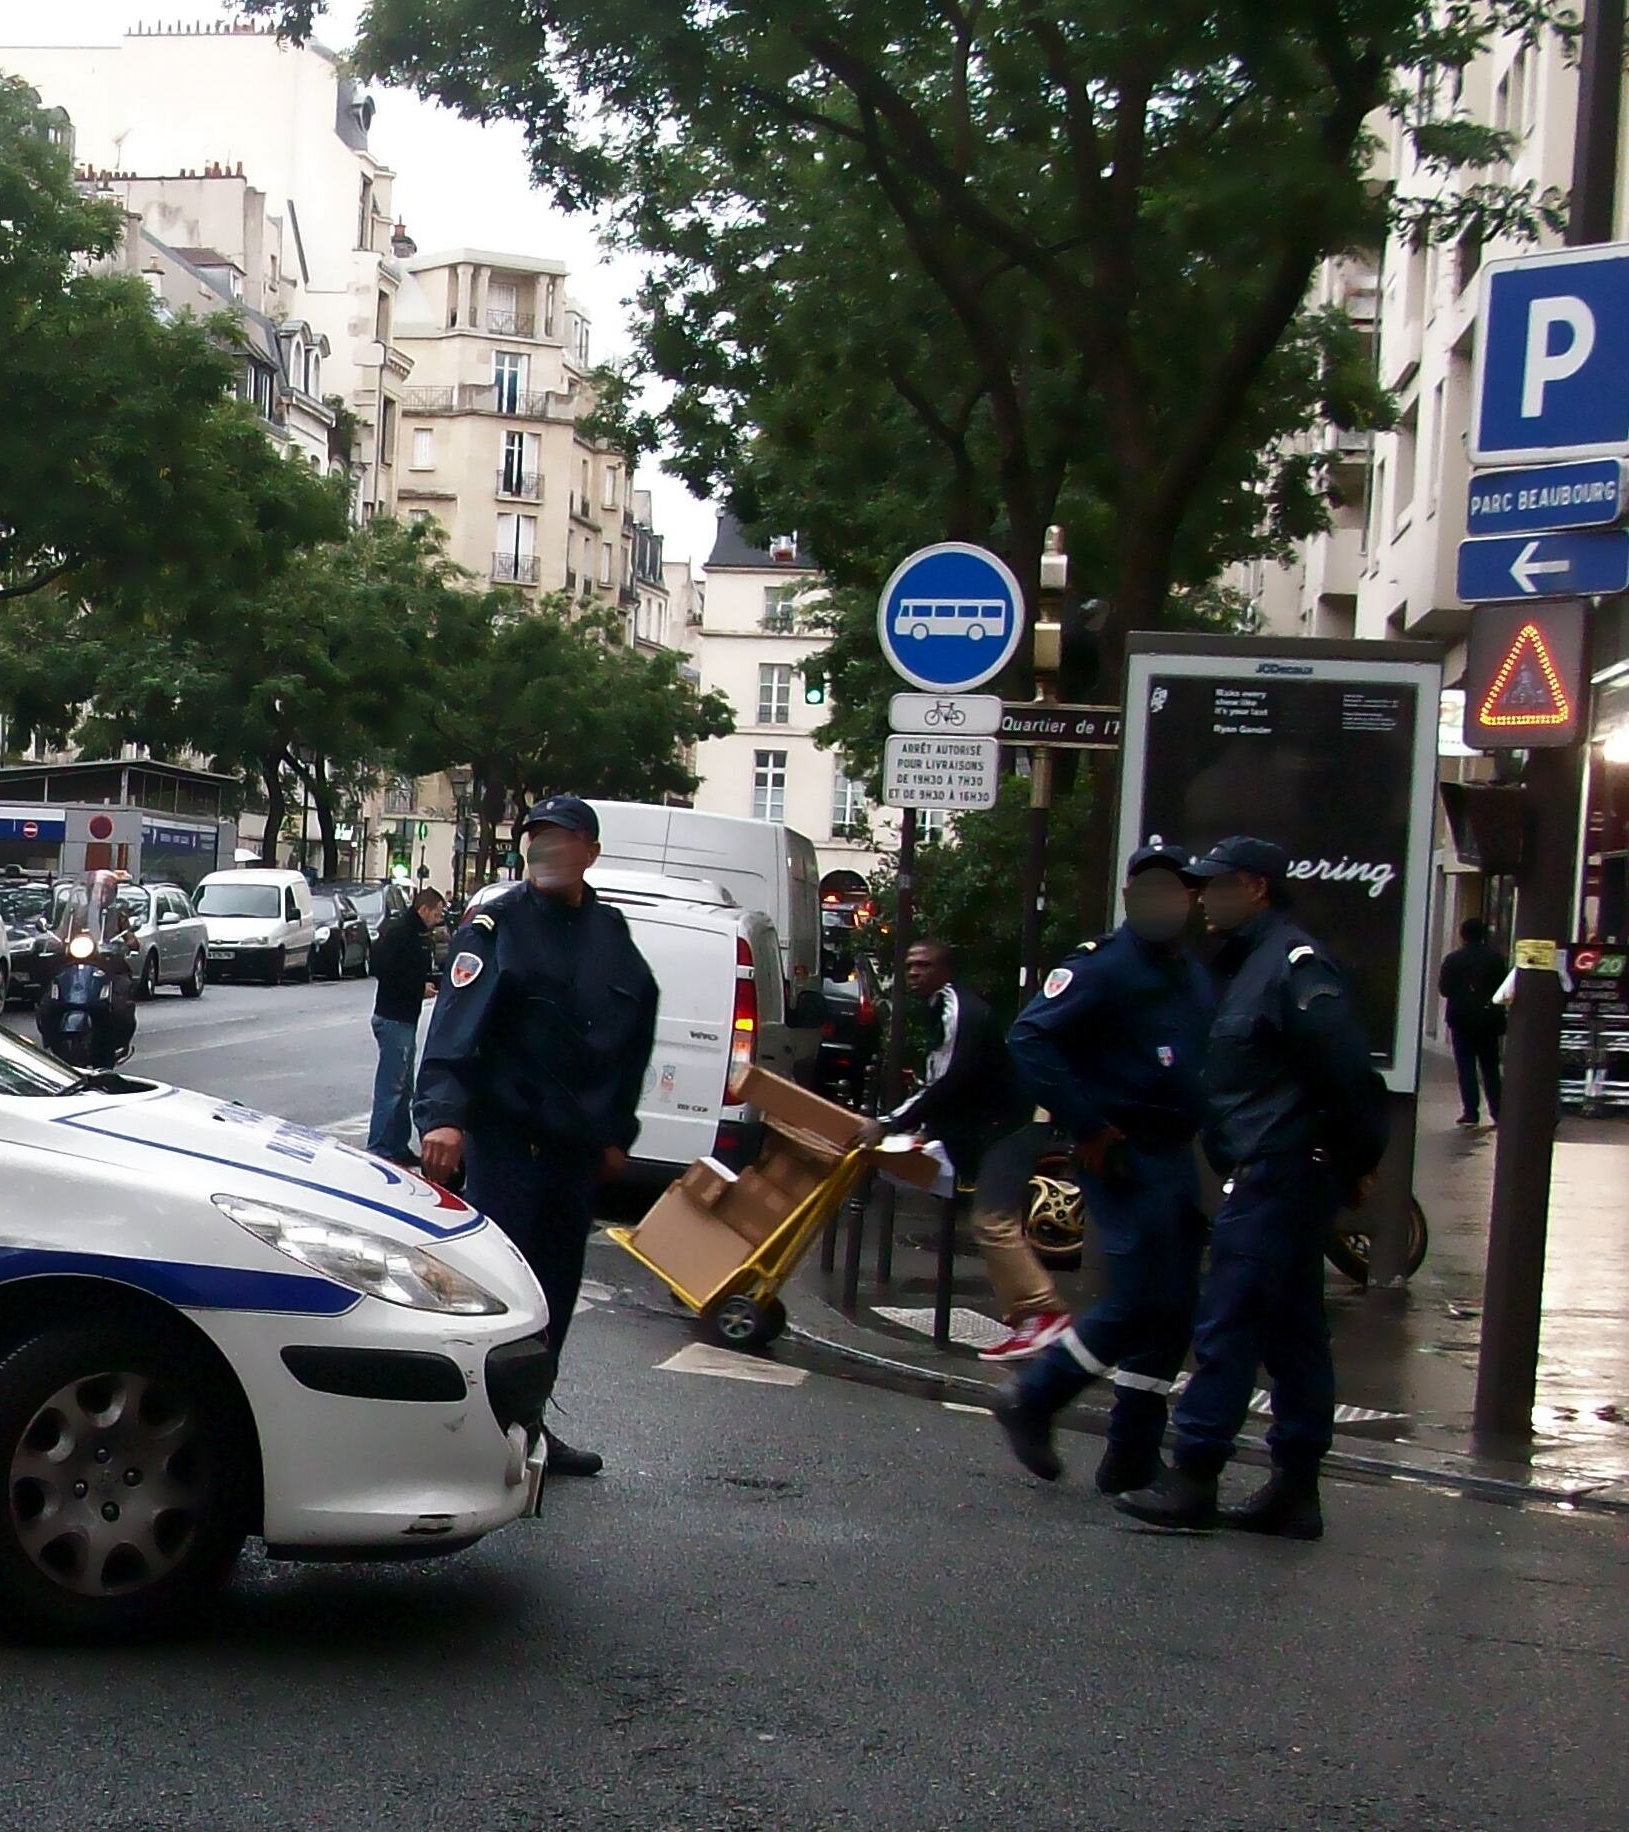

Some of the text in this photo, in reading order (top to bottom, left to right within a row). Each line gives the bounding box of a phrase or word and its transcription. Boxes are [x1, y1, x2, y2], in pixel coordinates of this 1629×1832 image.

[1521, 295, 1596, 419] P
[1471, 480, 1616, 516] PARC BEAUBOURG
[1002, 715, 1067, 733] Quartier
[1075, 719, 1095, 735] de
[902, 741, 932, 755] ARRÊT
[897, 758, 984, 771] POUR LIVRAISONS
[897, 774, 908, 784] DE
[913, 775, 943, 786] 19H30
[958, 775, 984, 787] 7H30
[889, 789, 901, 799] ET
[903, 789, 916, 799] DE
[919, 790, 945, 801] 9H30
[960, 791, 990, 802] 16H30
